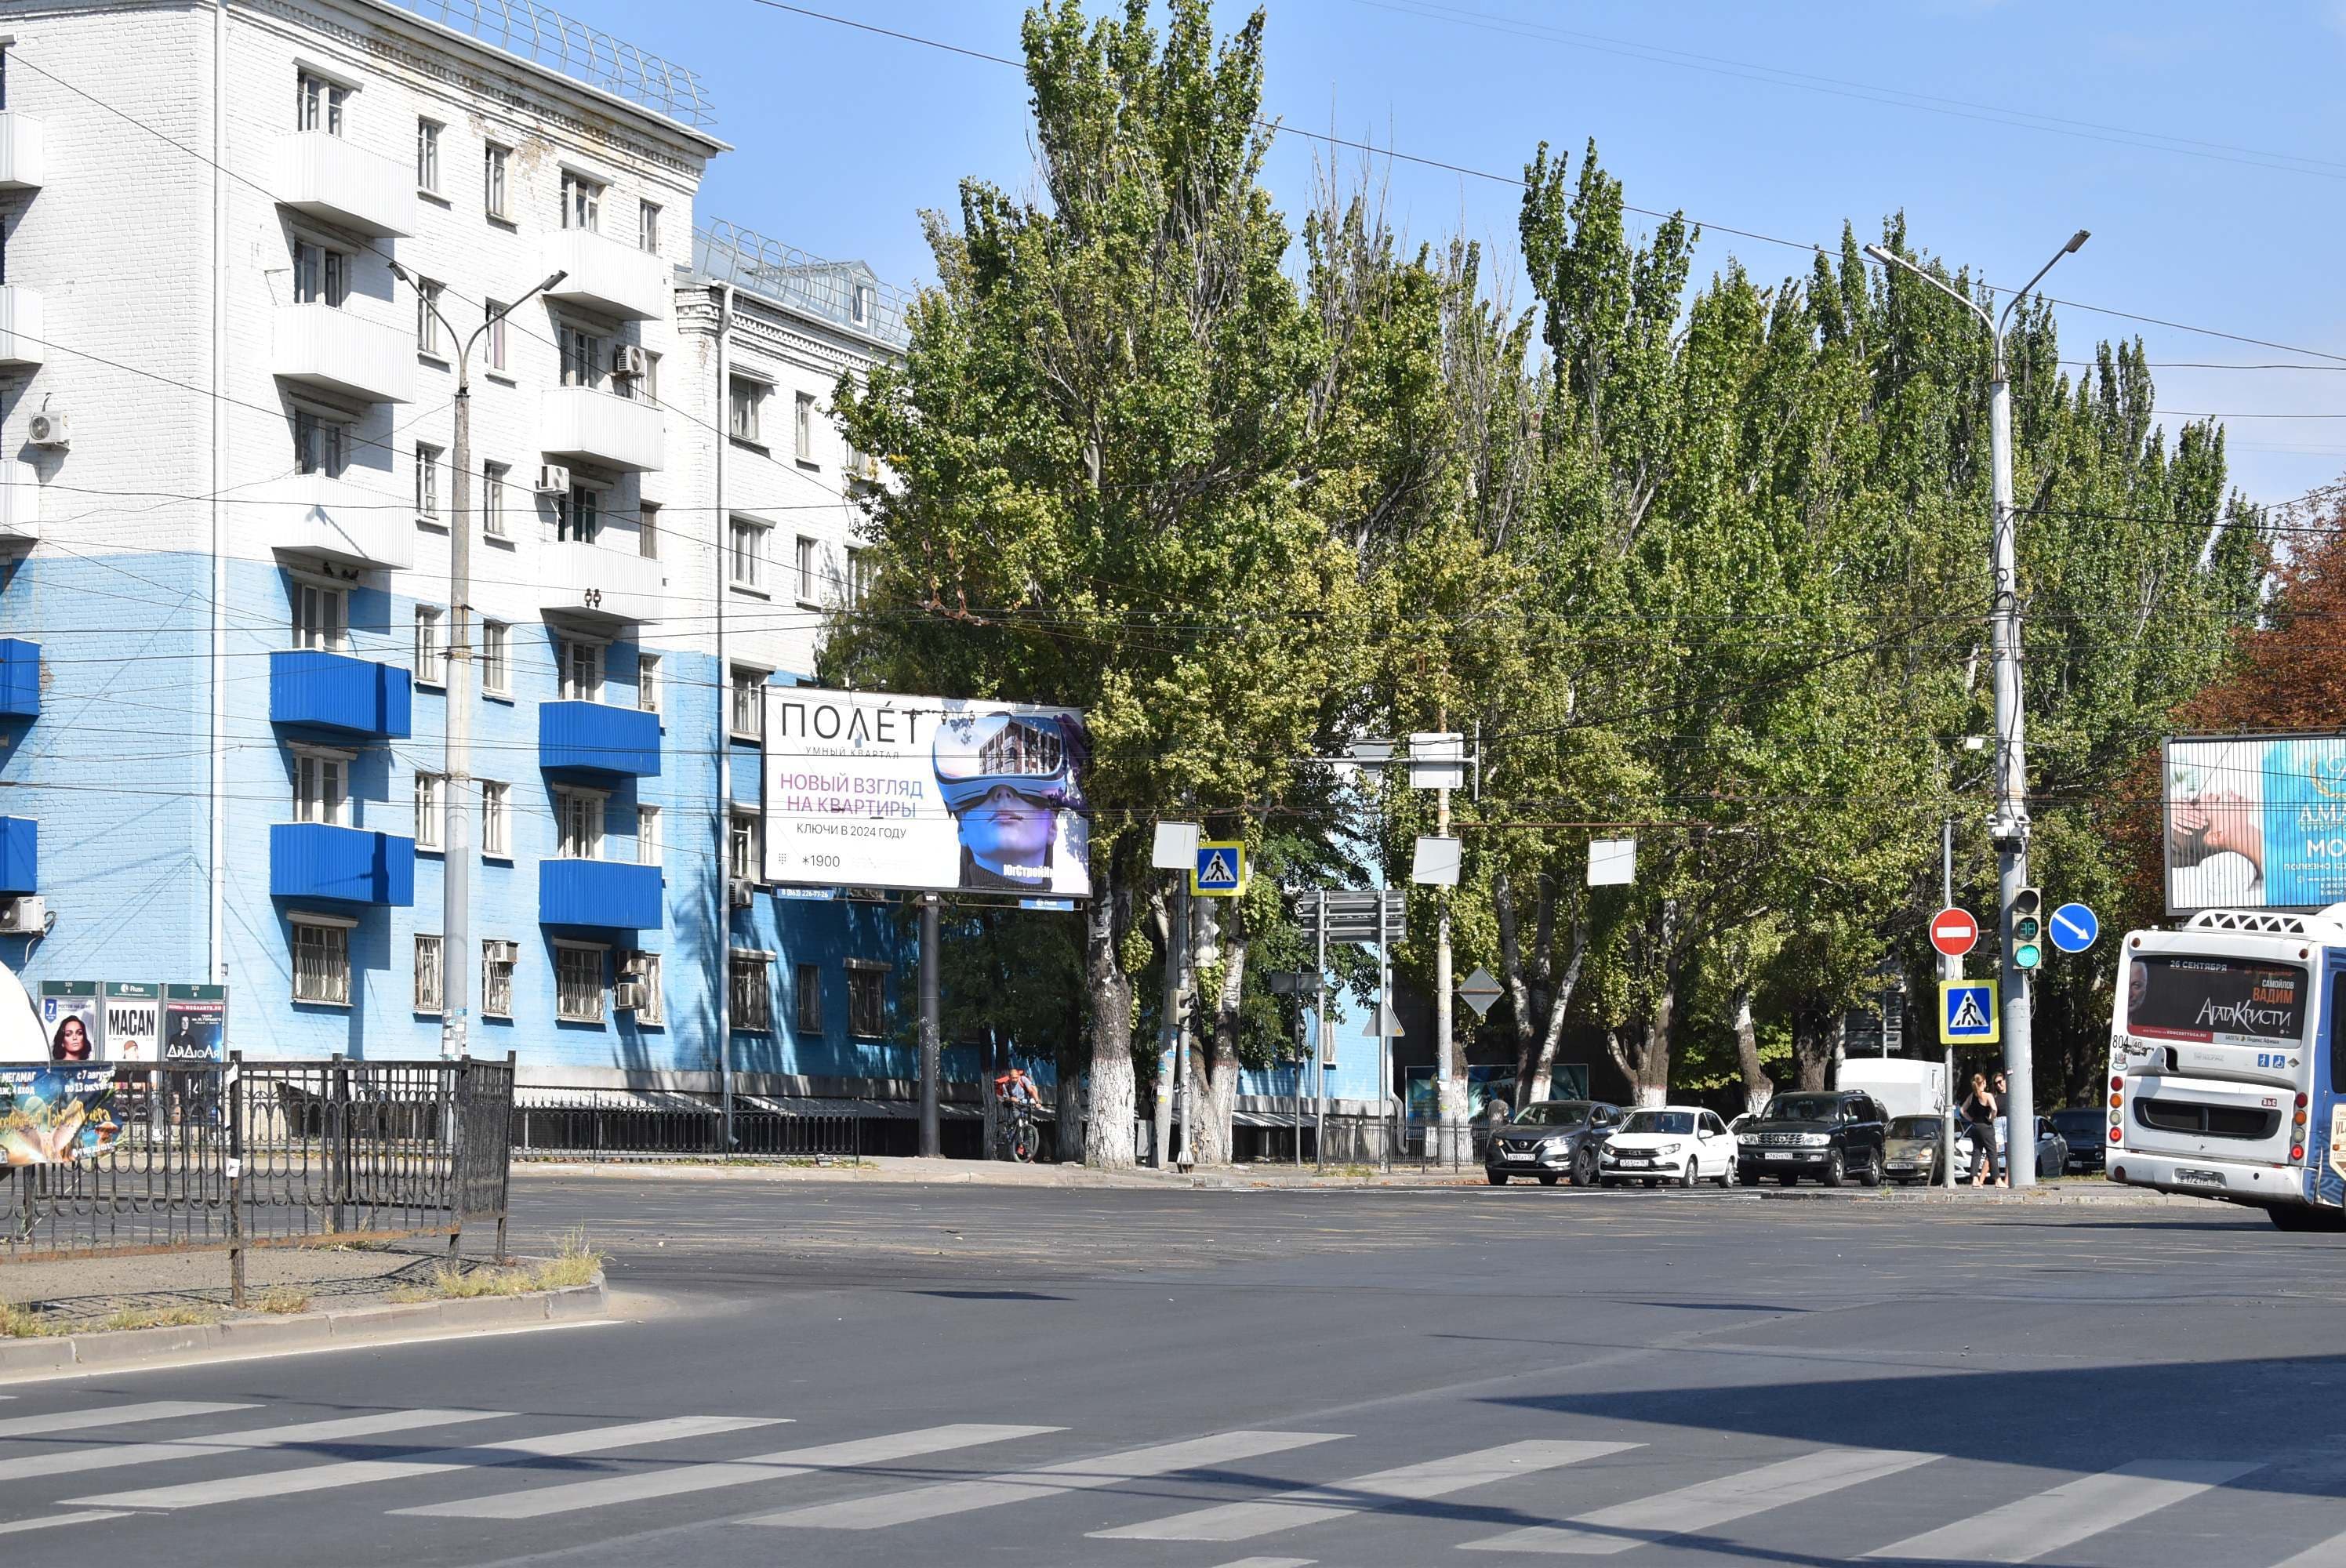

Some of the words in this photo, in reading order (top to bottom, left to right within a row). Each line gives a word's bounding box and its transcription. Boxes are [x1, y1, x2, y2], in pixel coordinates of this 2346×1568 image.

[806, 746, 846, 756] УМНЫЙ
[851, 750, 899, 759] КВАРТАЛ
[781, 772, 848, 792] НОВЫЙ
[854, 777, 923, 799] ВЗГЛЯД
[787, 796, 812, 812] НА
[818, 797, 916, 818] КВАРТИРЫ
[797, 823, 838, 835] КЛЮЧИ
[841, 826, 848, 835] В
[851, 826, 876, 837] 2024
[879, 828, 906, 840] ГОДУ
[2170, 960, 2180, 968] 26
[2182, 961, 2228, 972] СЕНТЯБРЯ
[2262, 979, 2294, 989] САМОЙЛОВ
[2253, 987, 2293, 1004] ВАДИМ
[48, 1003, 55, 1014] 7
[109, 1009, 154, 1036] MACAN
[2, 1072, 37, 1082] МЕГАМАГ
